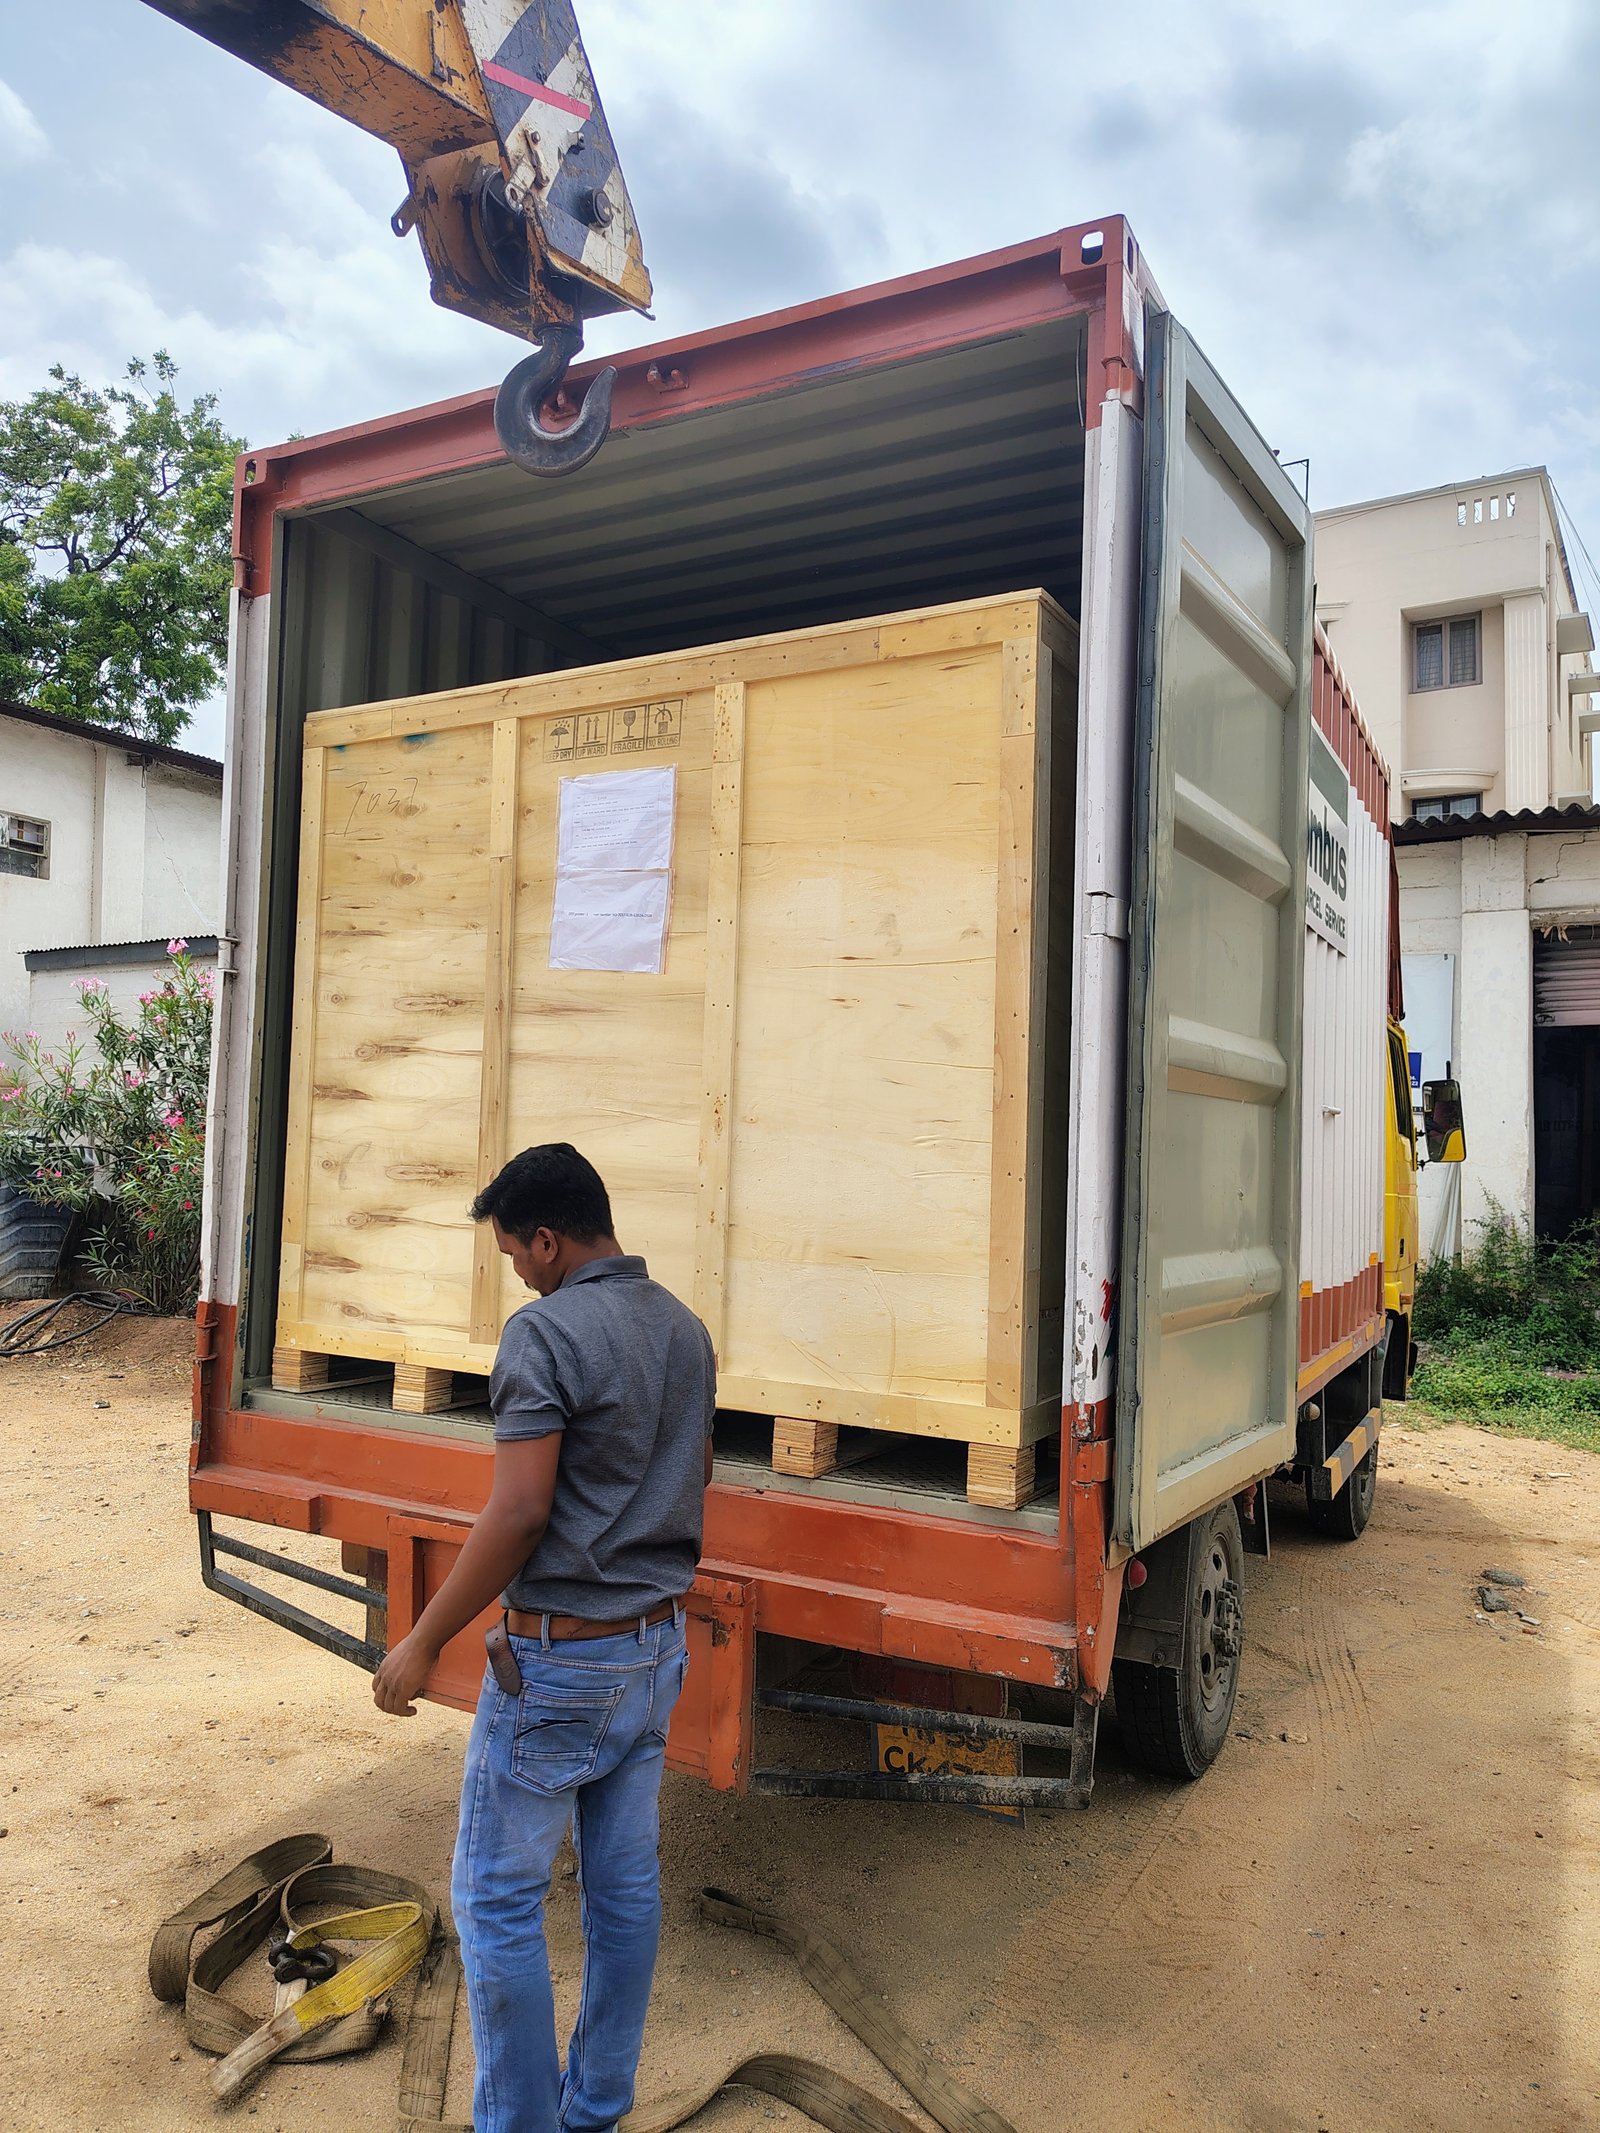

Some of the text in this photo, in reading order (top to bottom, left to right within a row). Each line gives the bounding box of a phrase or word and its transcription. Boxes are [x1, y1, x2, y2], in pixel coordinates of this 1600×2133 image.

[613, 740, 643, 751] FRAGILE
[649, 736, 679, 748] NO ROLLING
[560, 749, 572, 760] DRY
[577, 746, 606, 757] UP WARD
[1325, 902, 1346, 940] SERVICE
